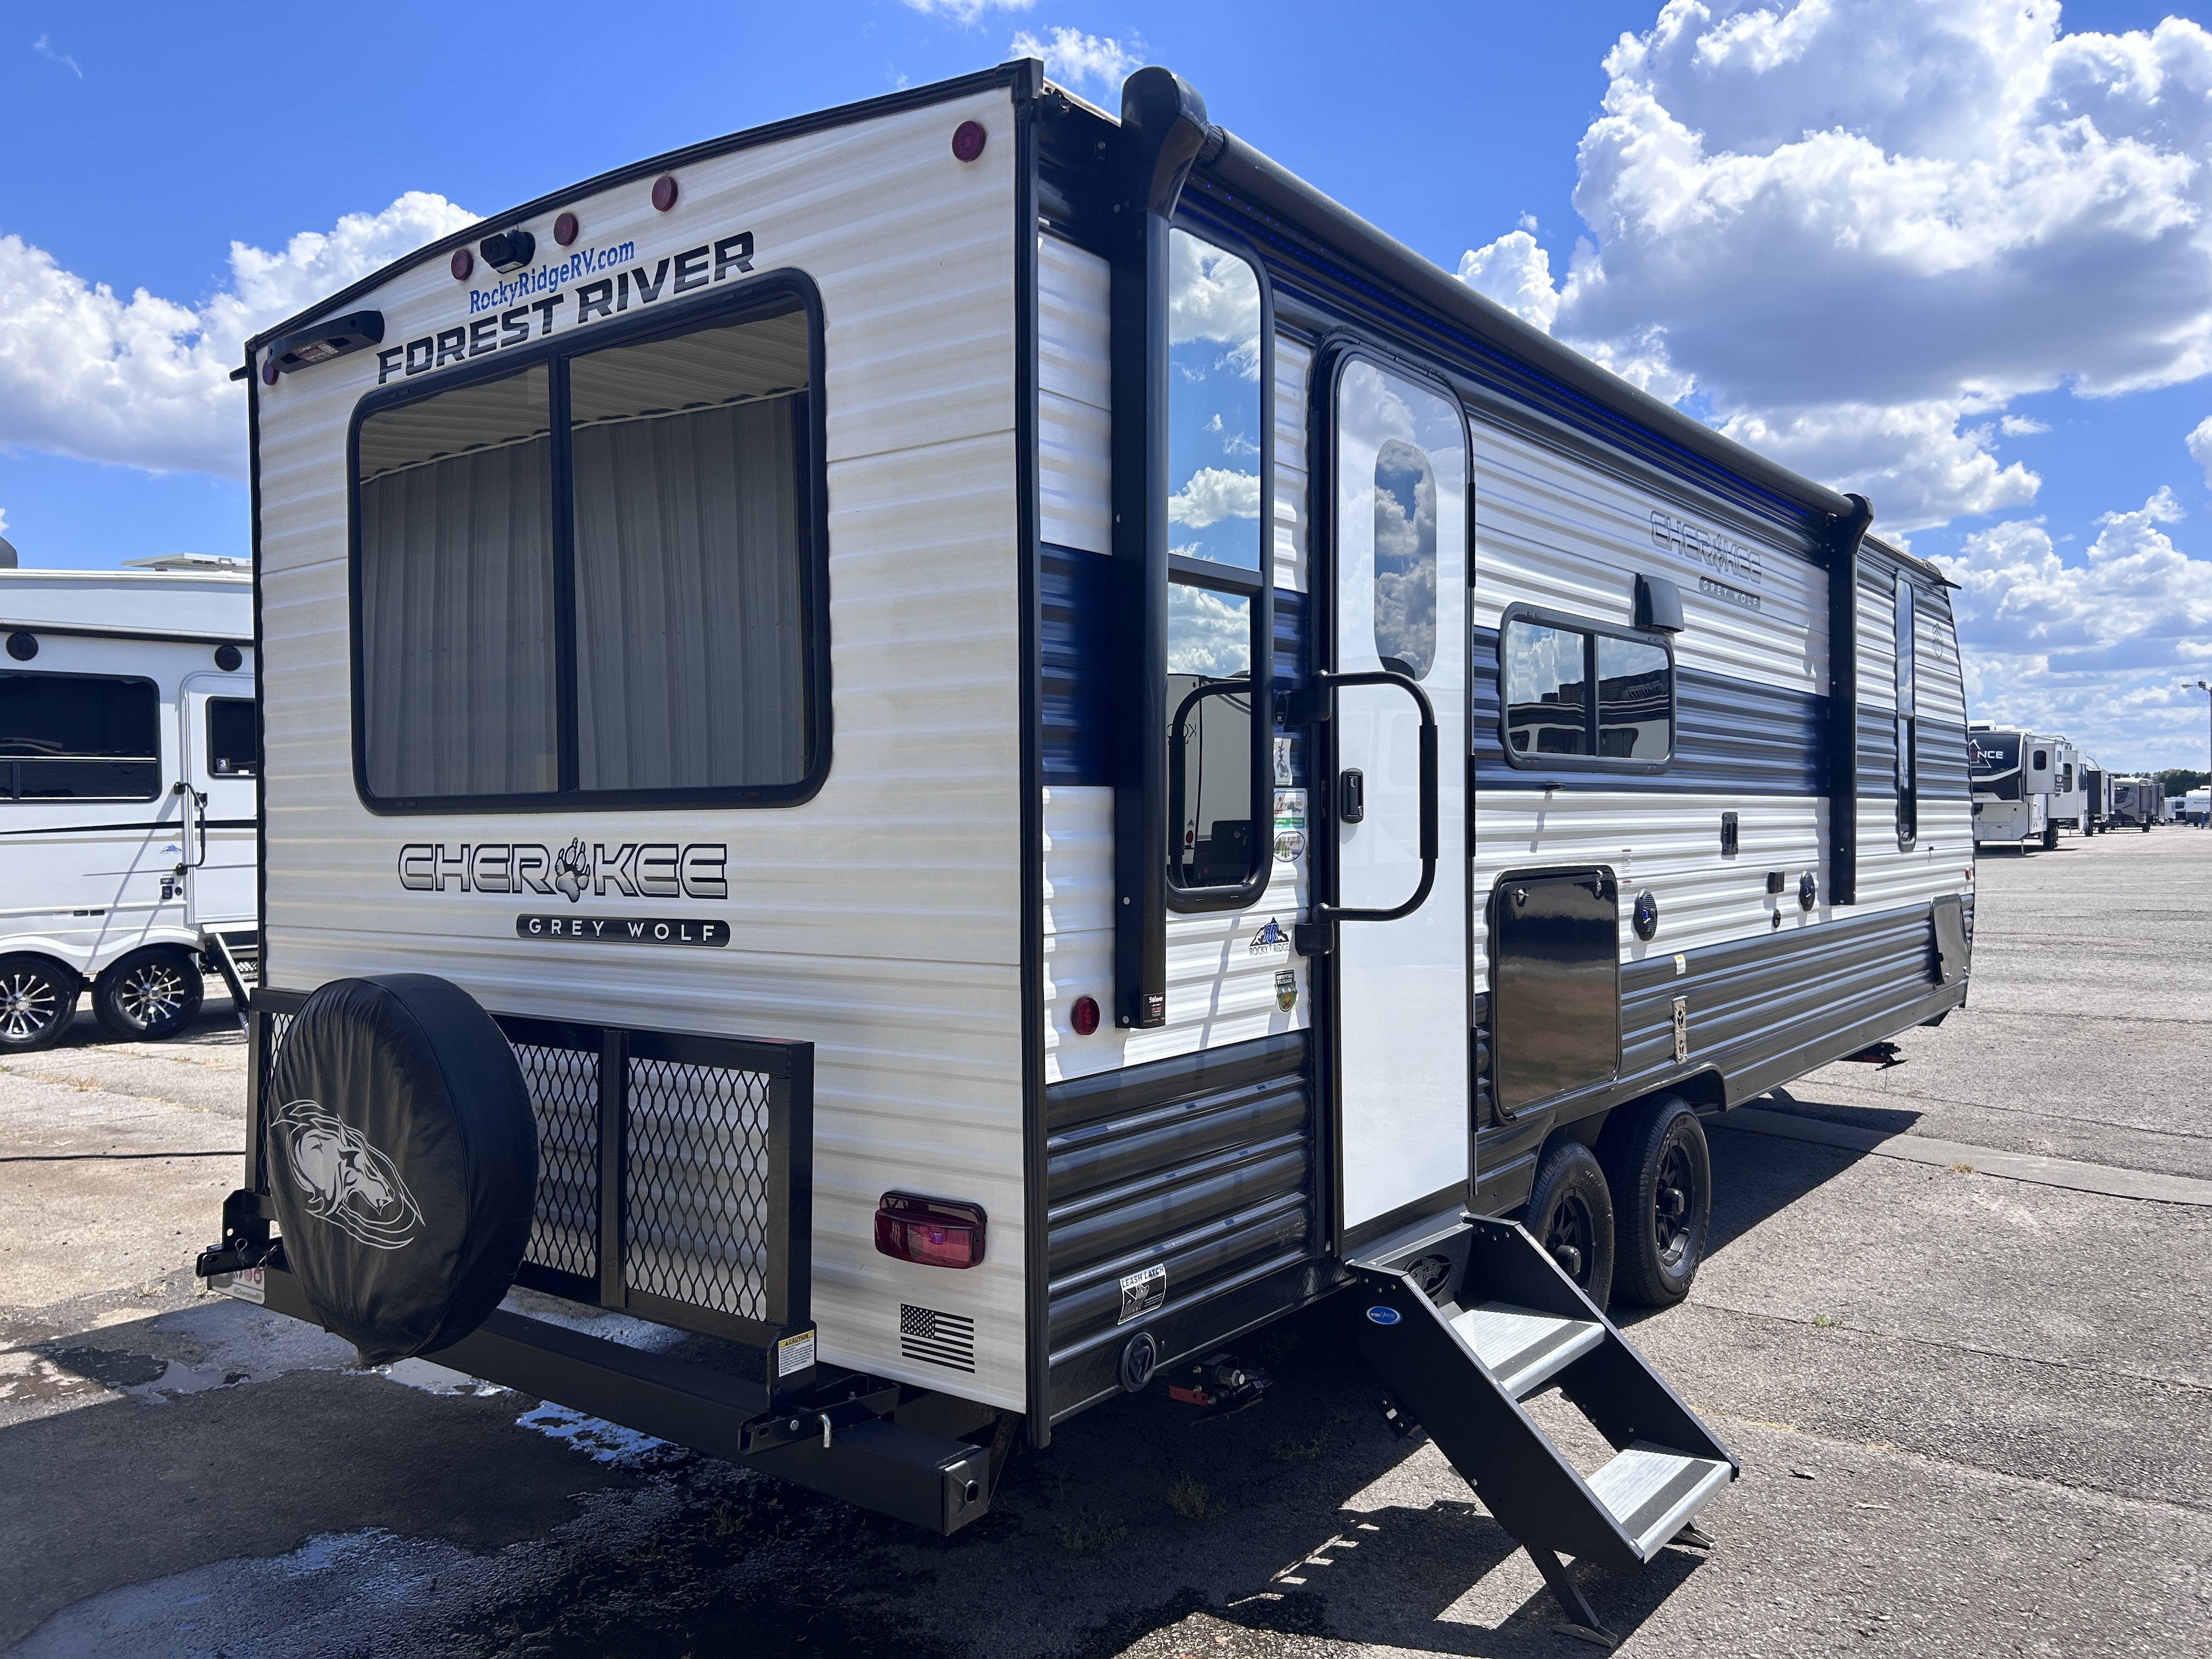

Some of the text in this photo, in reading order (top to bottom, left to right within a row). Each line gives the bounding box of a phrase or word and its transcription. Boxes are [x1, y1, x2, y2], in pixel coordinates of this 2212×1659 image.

[469, 241, 635, 313] RockyRidgeRV.com
[376, 230, 755, 385] FOREST RIVER
[1702, 580, 1758, 607] GREY WOLF
[398, 837, 728, 903] CHEROKEE
[529, 918, 715, 942] GREY WOLF
[1249, 943, 1289, 956] ROCKY RIDGE
[1121, 1266, 1164, 1288] LEASH LATCH
[788, 1334, 809, 1345] CAUTION
